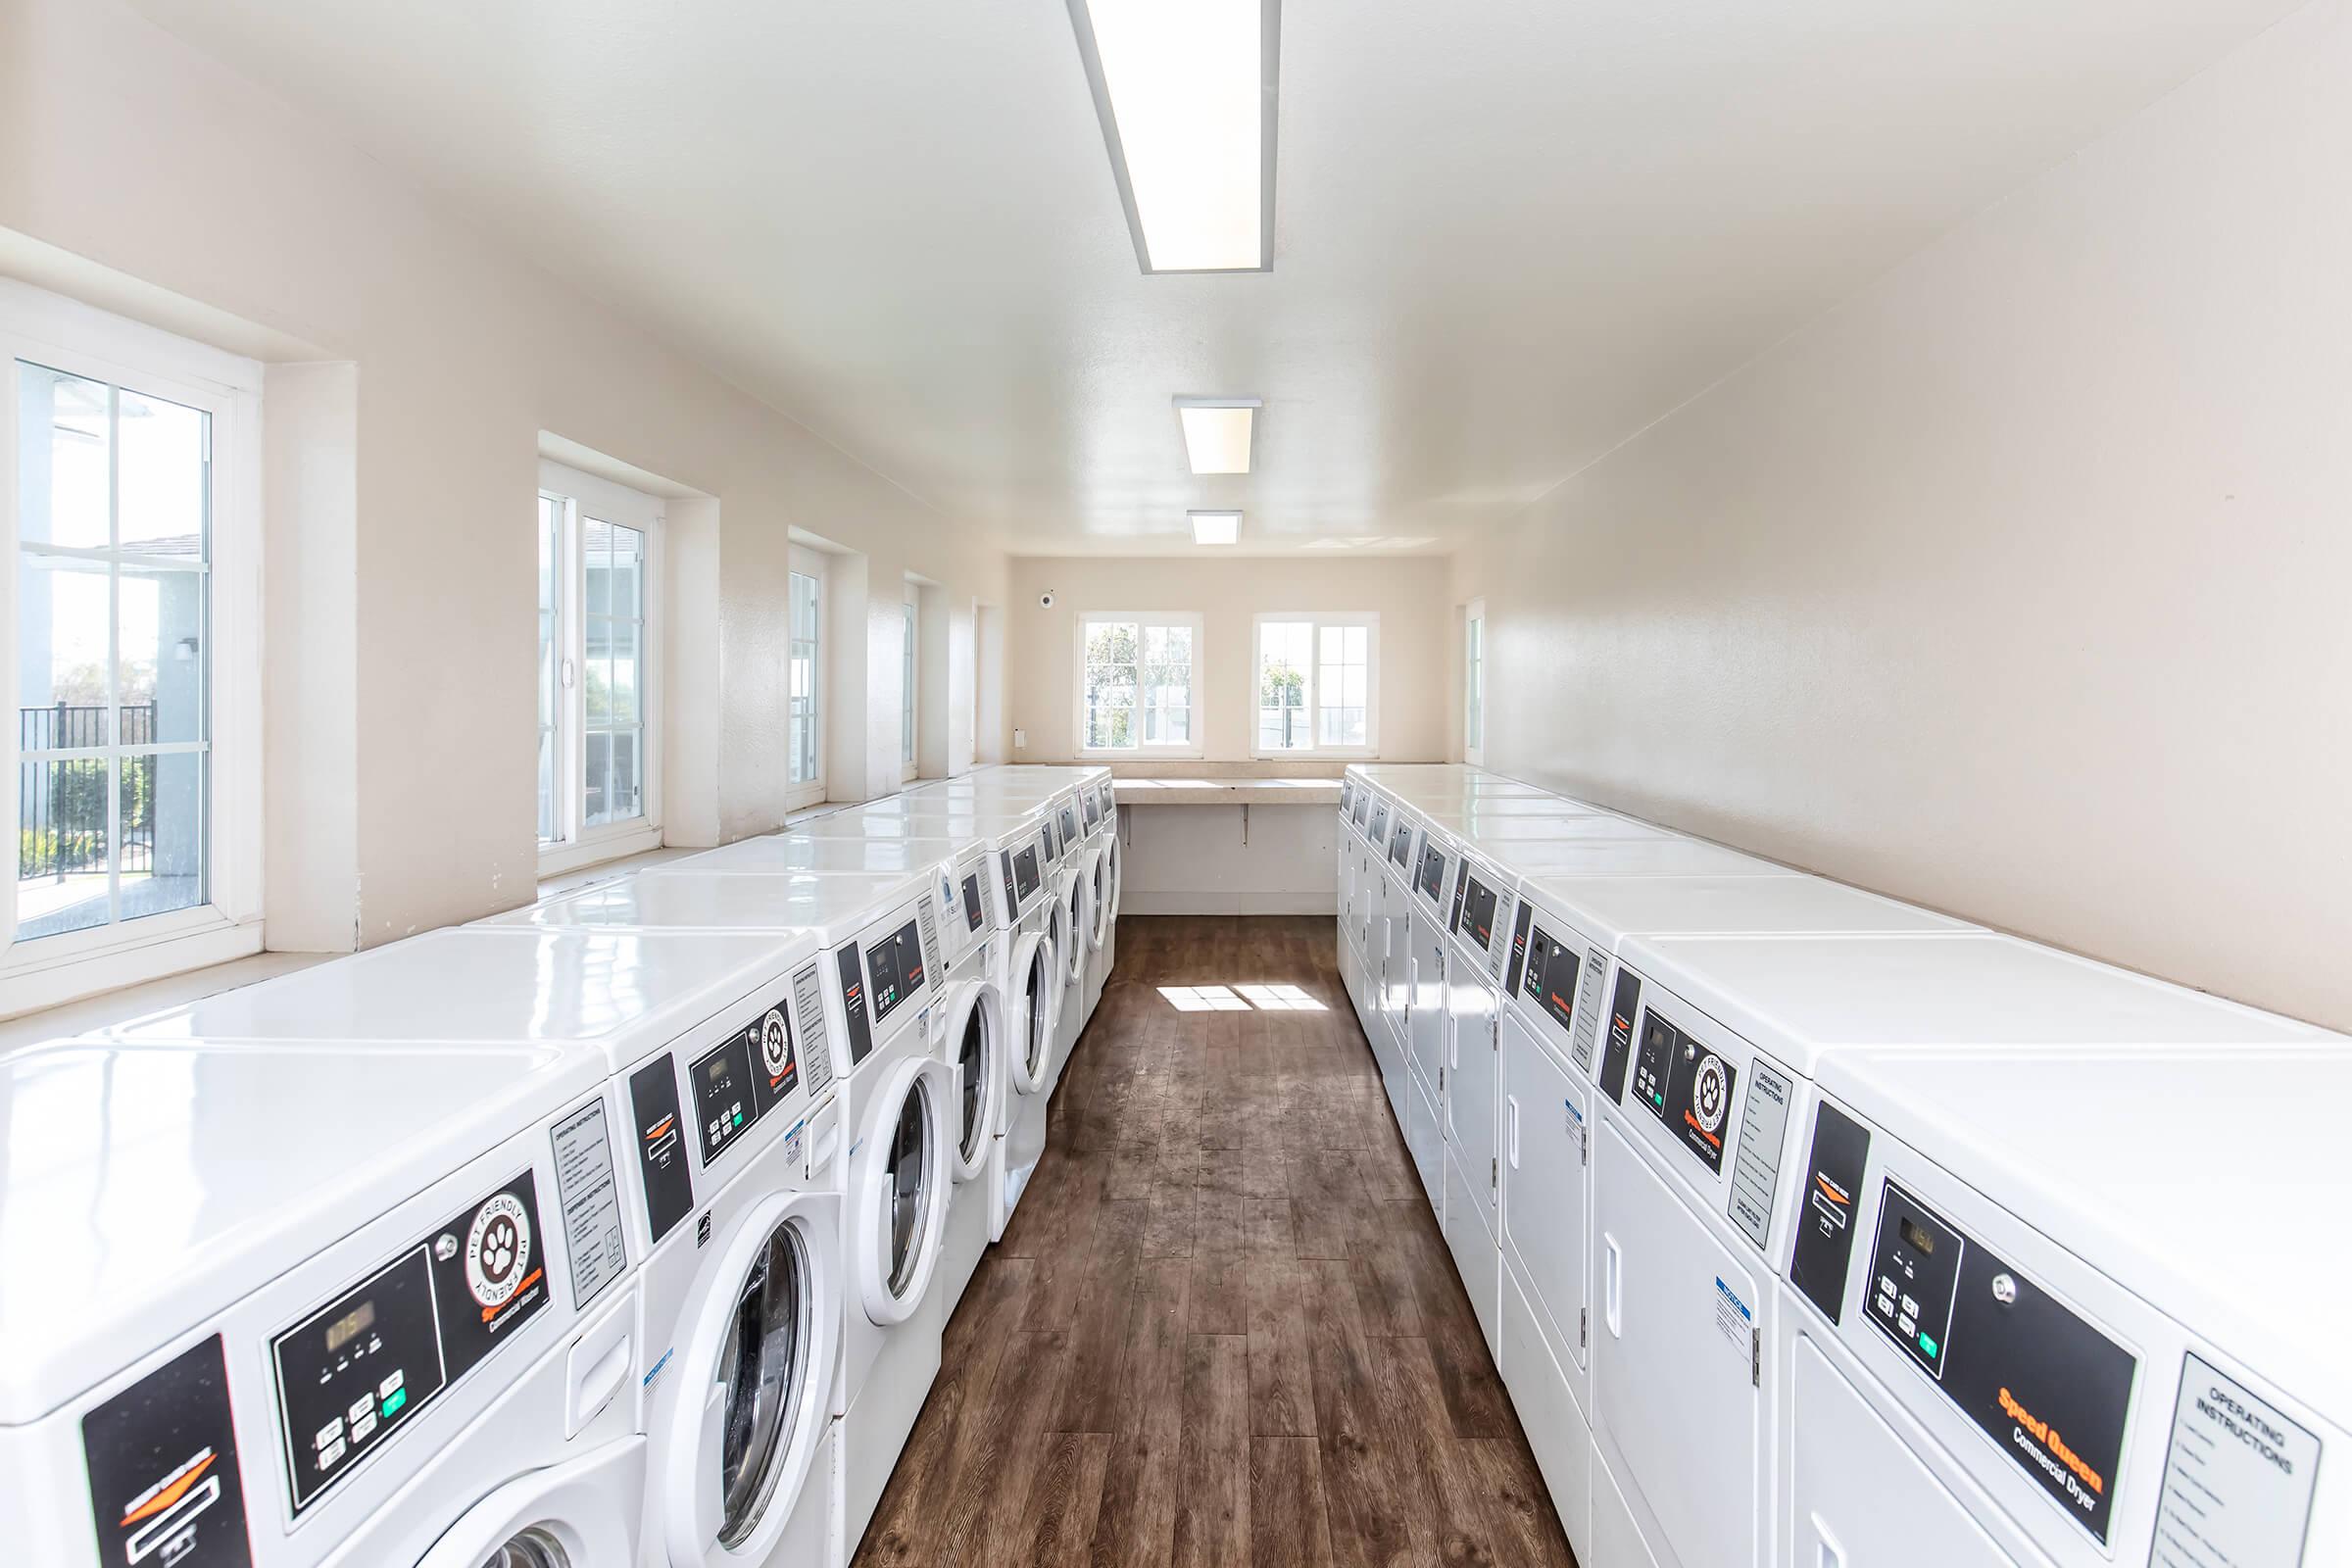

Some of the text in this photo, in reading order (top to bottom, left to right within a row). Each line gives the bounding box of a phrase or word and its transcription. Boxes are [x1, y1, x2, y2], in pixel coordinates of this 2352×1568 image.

[1707, 1057, 1725, 1092] FRIENDLY
[1755, 1080, 1784, 1105] INSTRUCTIONS
[1759, 1072, 1782, 1093] OPERATING
[469, 1199, 522, 1258] PET FRIENDLY
[517, 1240, 527, 1268] PET
[475, 1273, 518, 1301] FRIENDLY
[2195, 1396, 2293, 1475] INSTRUCTIONS
[2209, 1386, 2284, 1448] OPERATING
[1998, 1387, 2048, 1444] Speed
[2046, 1429, 2103, 1495] Queen
[2013, 1426, 2096, 1511] Commercial Dryer
